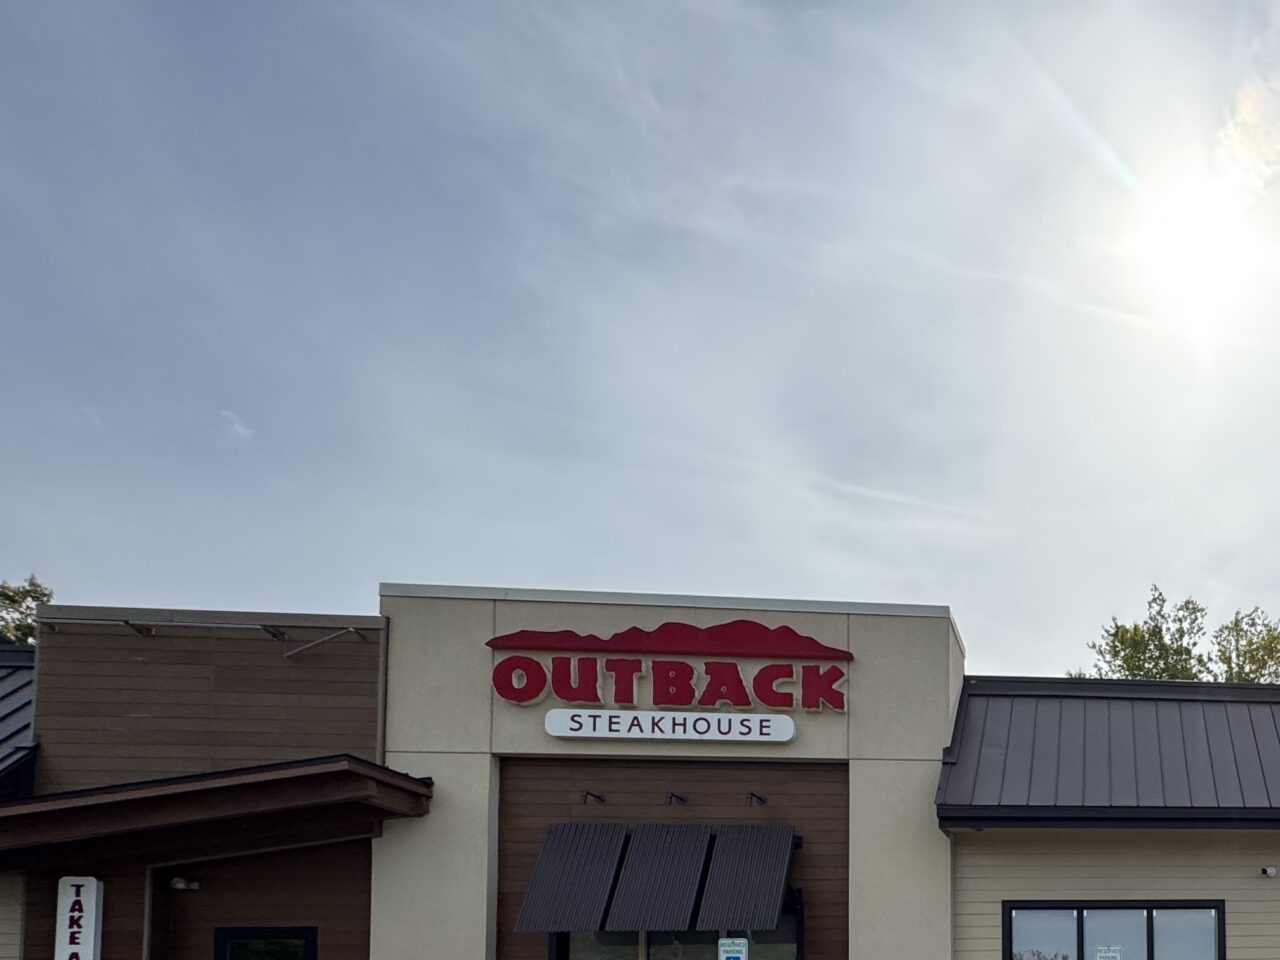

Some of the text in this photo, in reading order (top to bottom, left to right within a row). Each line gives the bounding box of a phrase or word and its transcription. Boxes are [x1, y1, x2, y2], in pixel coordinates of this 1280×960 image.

[492, 655, 847, 712] OUTBACK
[569, 714, 772, 737] STEAKHOUSE
[68, 884, 85, 945] TAKE
